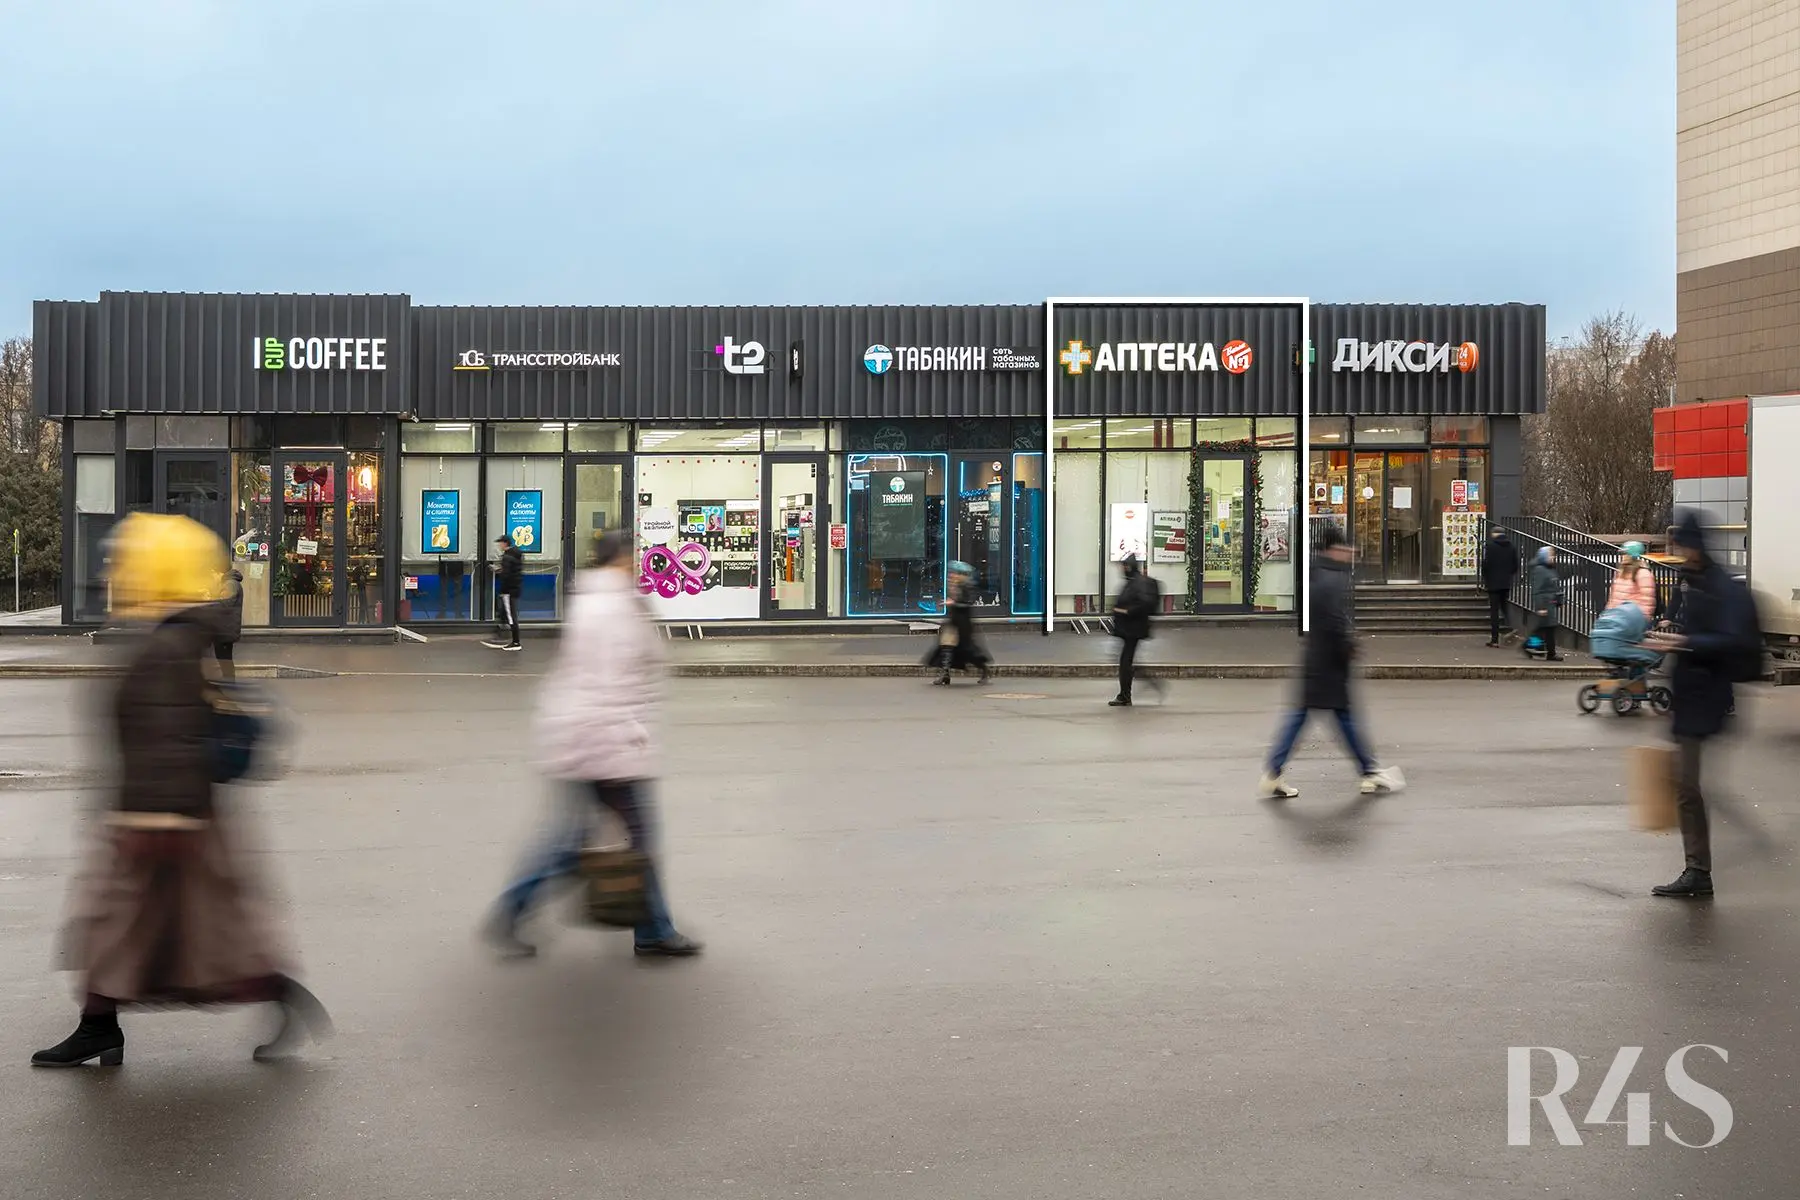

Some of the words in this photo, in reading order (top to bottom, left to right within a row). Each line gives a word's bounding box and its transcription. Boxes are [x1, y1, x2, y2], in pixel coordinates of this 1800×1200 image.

[264, 337, 285, 369] CUP
[289, 337, 387, 370] COFFEE
[492, 352, 621, 366] ТРАНССТРОЙБАНК
[715, 336, 765, 374] t2
[895, 346, 986, 371] ТАБАКИН
[992, 354, 1036, 362] табачных
[1094, 342, 1219, 371] АПТЕКА
[1332, 338, 1449, 373] ДИКСИ
[882, 493, 914, 504] ТАБАКИН
[662, 579, 676, 592] ГБ
